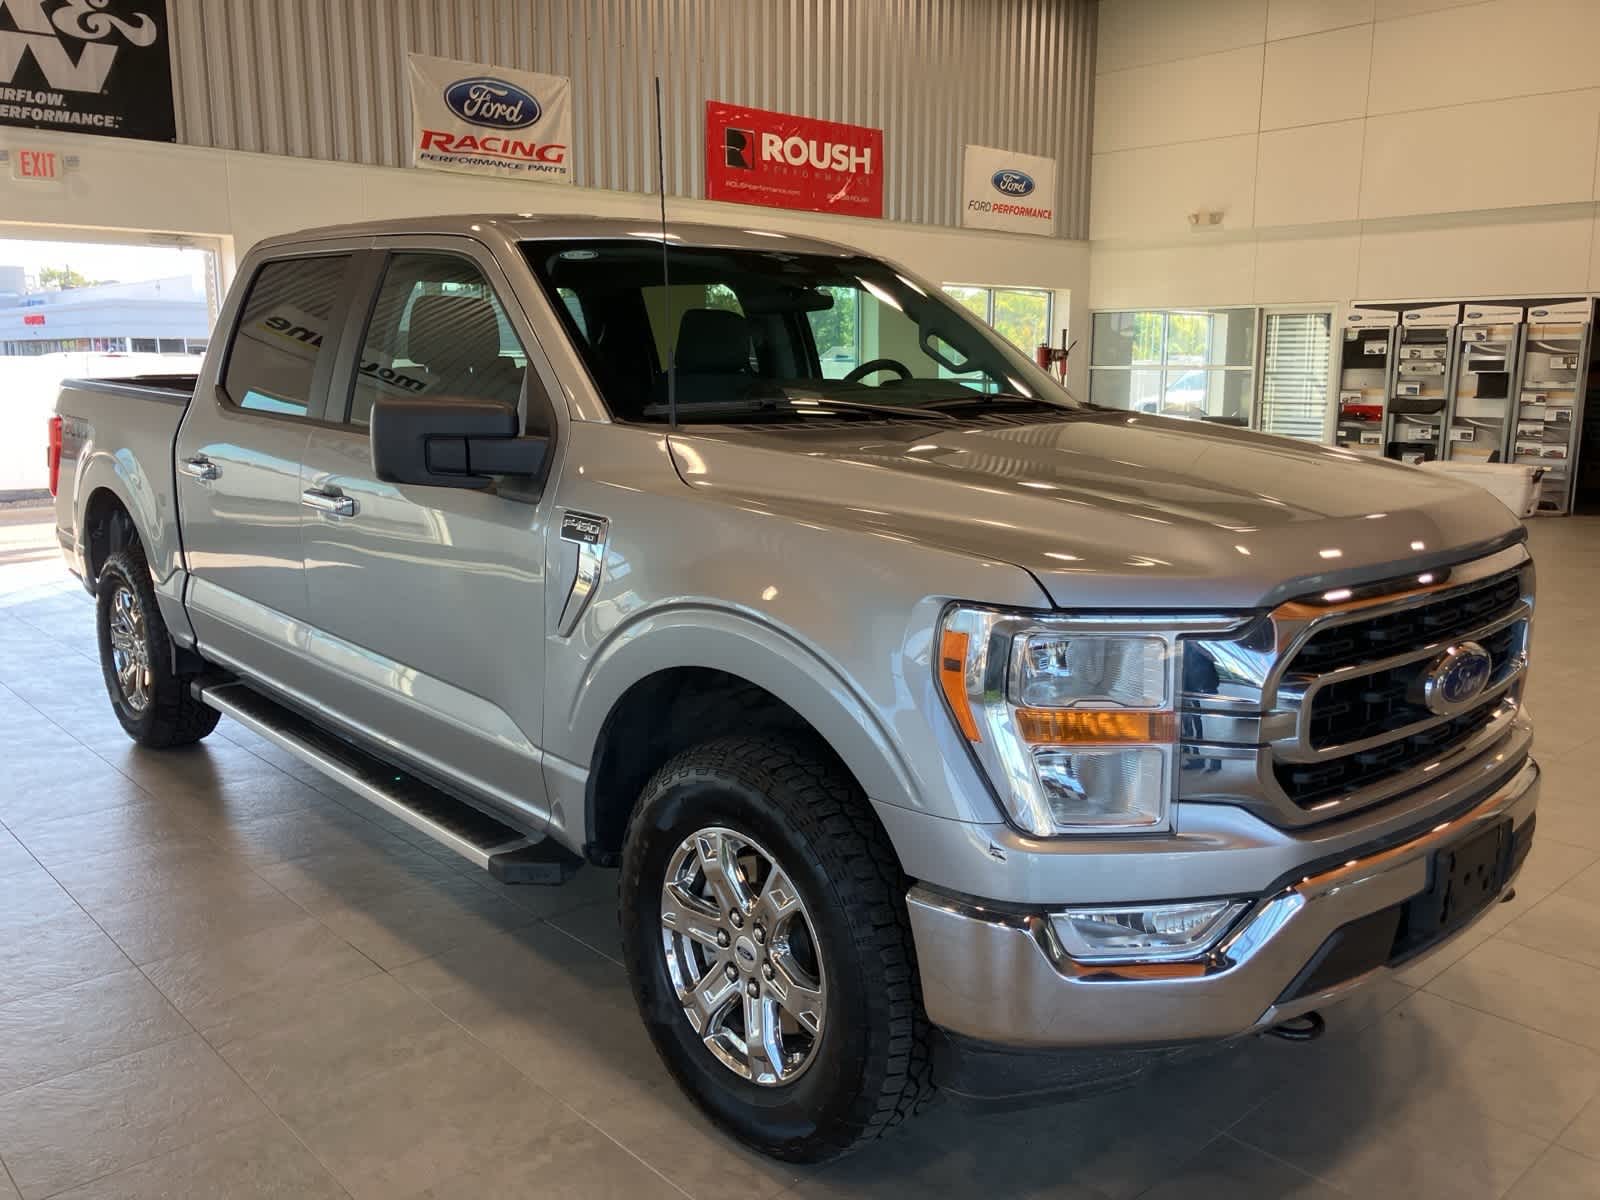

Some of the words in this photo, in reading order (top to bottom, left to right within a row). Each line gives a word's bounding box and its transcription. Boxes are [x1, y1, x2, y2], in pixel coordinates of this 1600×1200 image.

[463, 84, 523, 123] Ford
[420, 129, 567, 164] RACING
[761, 132, 871, 175] ROUSH
[20, 151, 56, 178] EXIT
[420, 152, 524, 170] PERFORMANCE
[527, 163, 567, 175] PARTS
[1000, 173, 1026, 193] Ford
[968, 200, 991, 212] FORD
[992, 203, 1053, 220] PERFORMANCE
